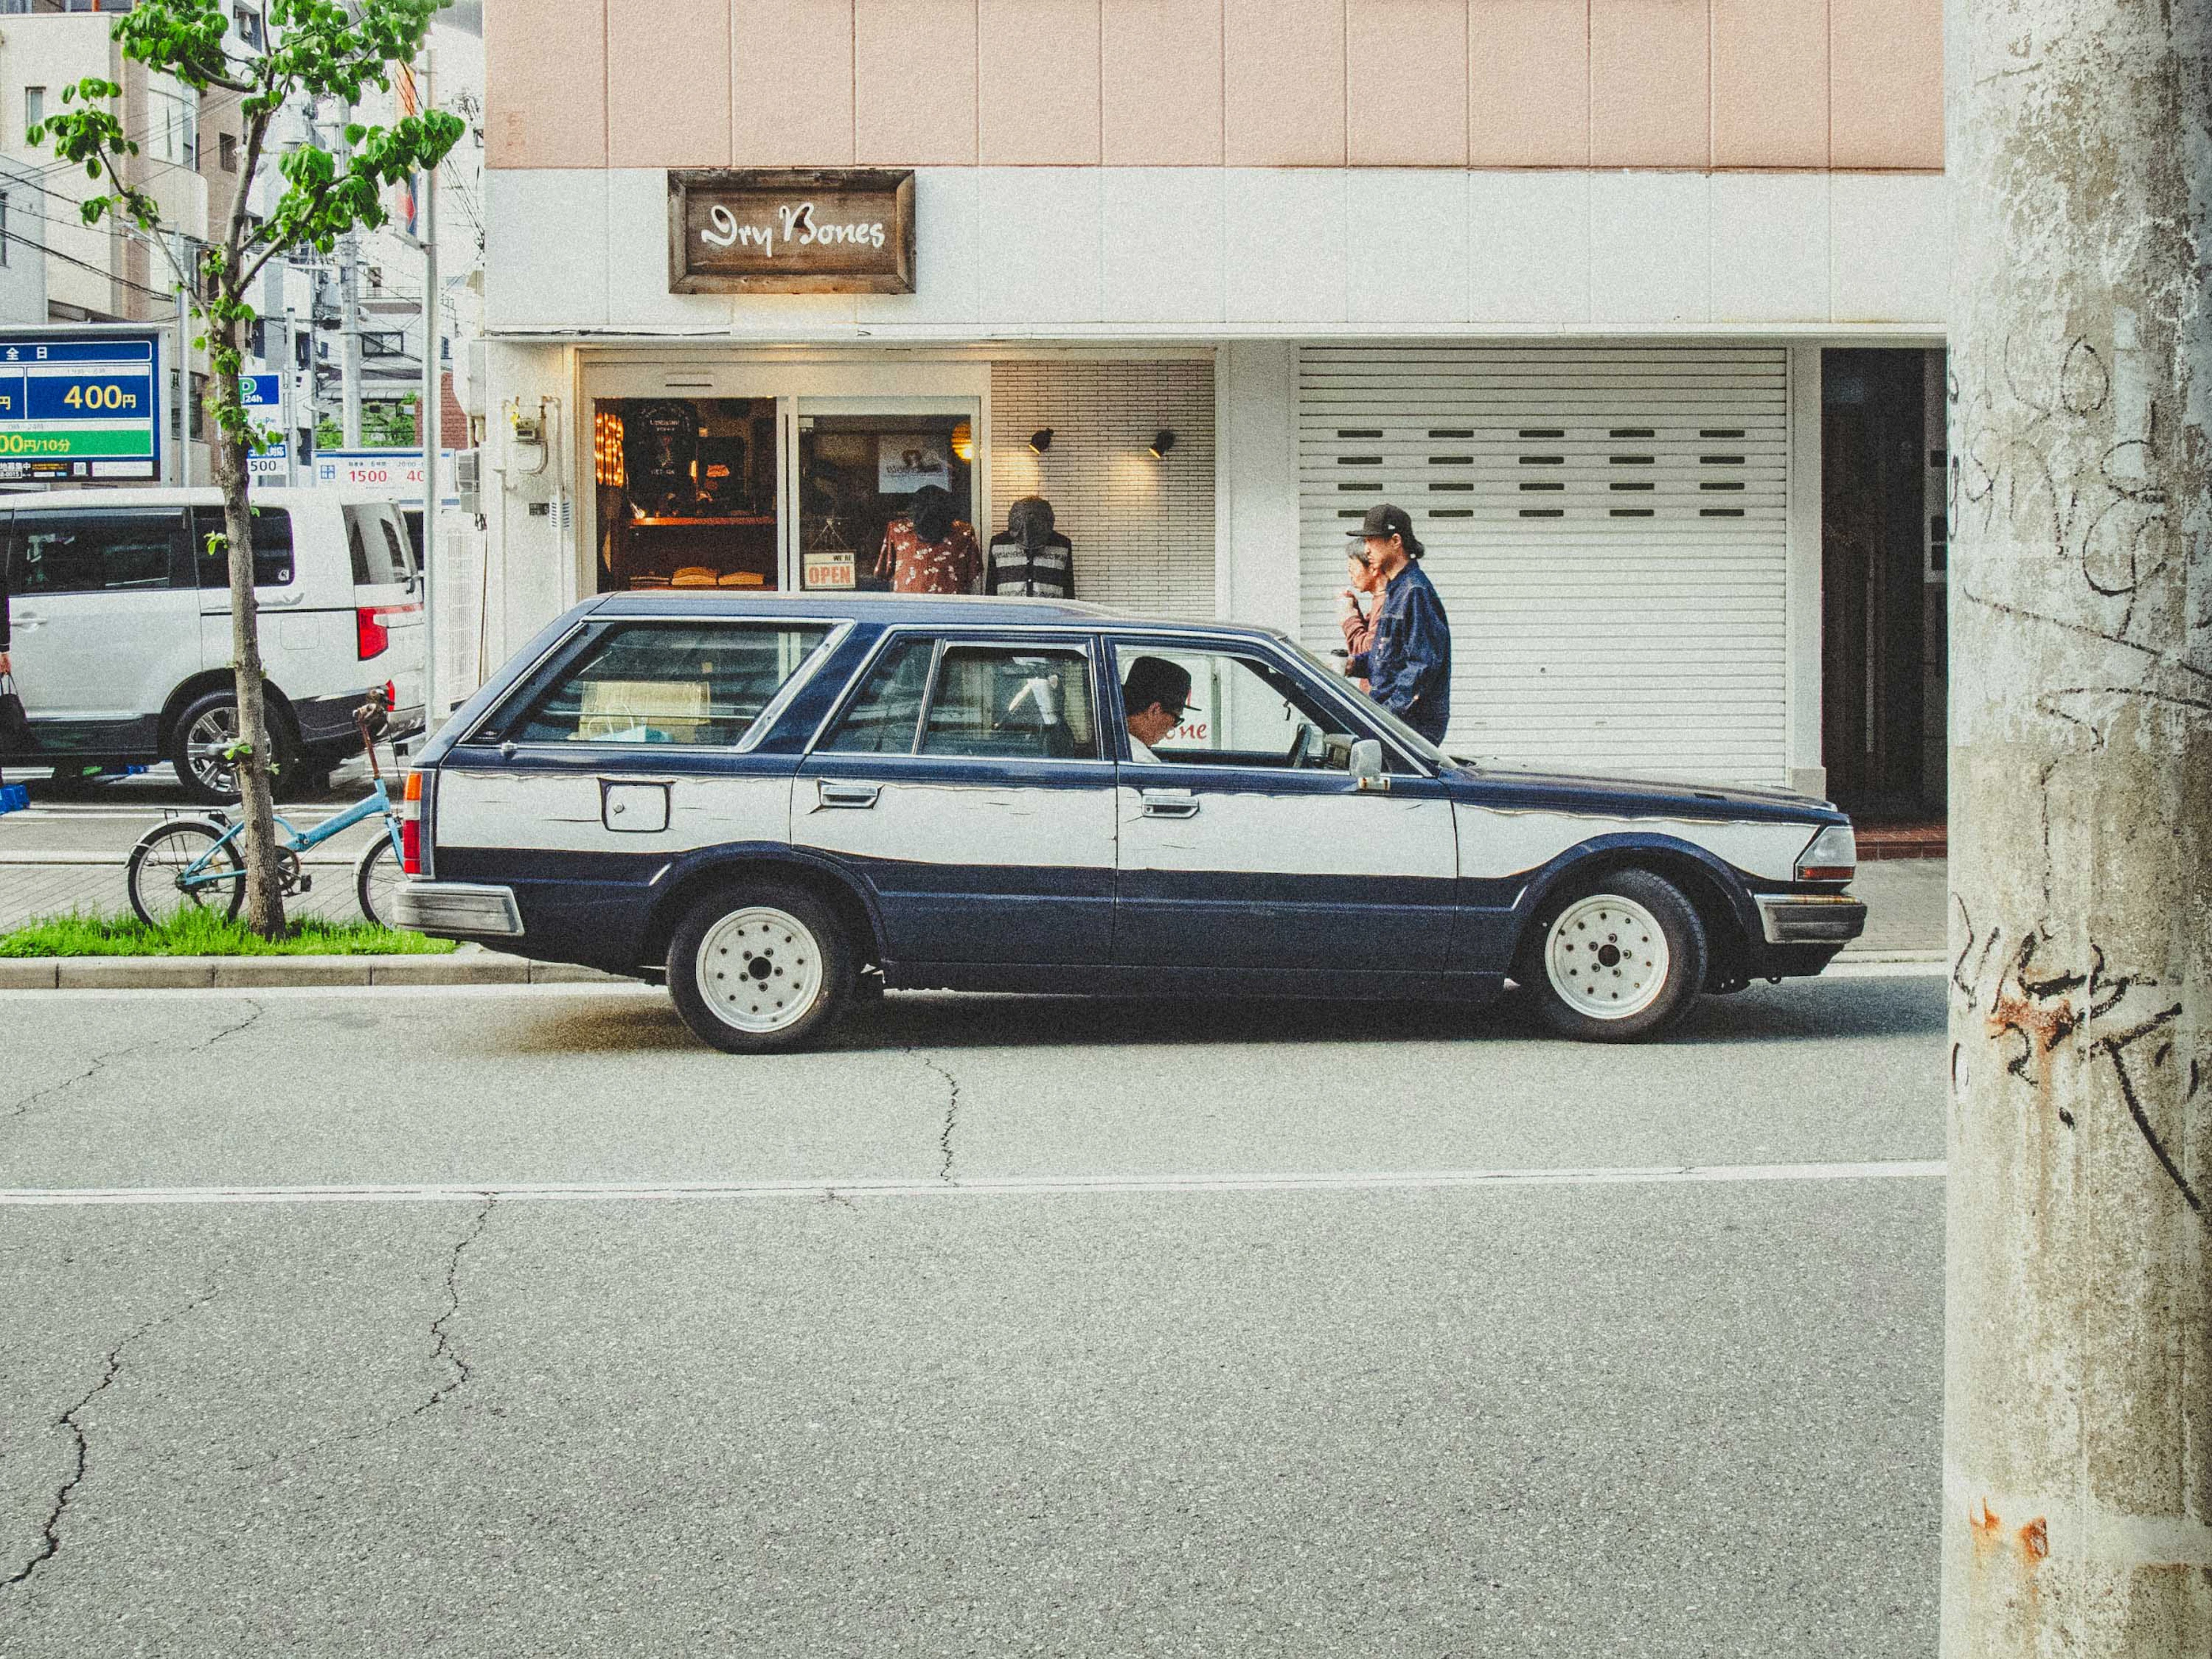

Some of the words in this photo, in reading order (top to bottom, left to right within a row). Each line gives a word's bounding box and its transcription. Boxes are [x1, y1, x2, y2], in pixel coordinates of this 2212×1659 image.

[700, 204, 773, 257] Dry
[779, 202, 885, 248] Bones
[63, 385, 137, 409] 400円
[245, 395, 263, 403] 24h
[250, 461, 276, 471] 500
[349, 470, 388, 482] 1500
[808, 566, 851, 584] OPEN
